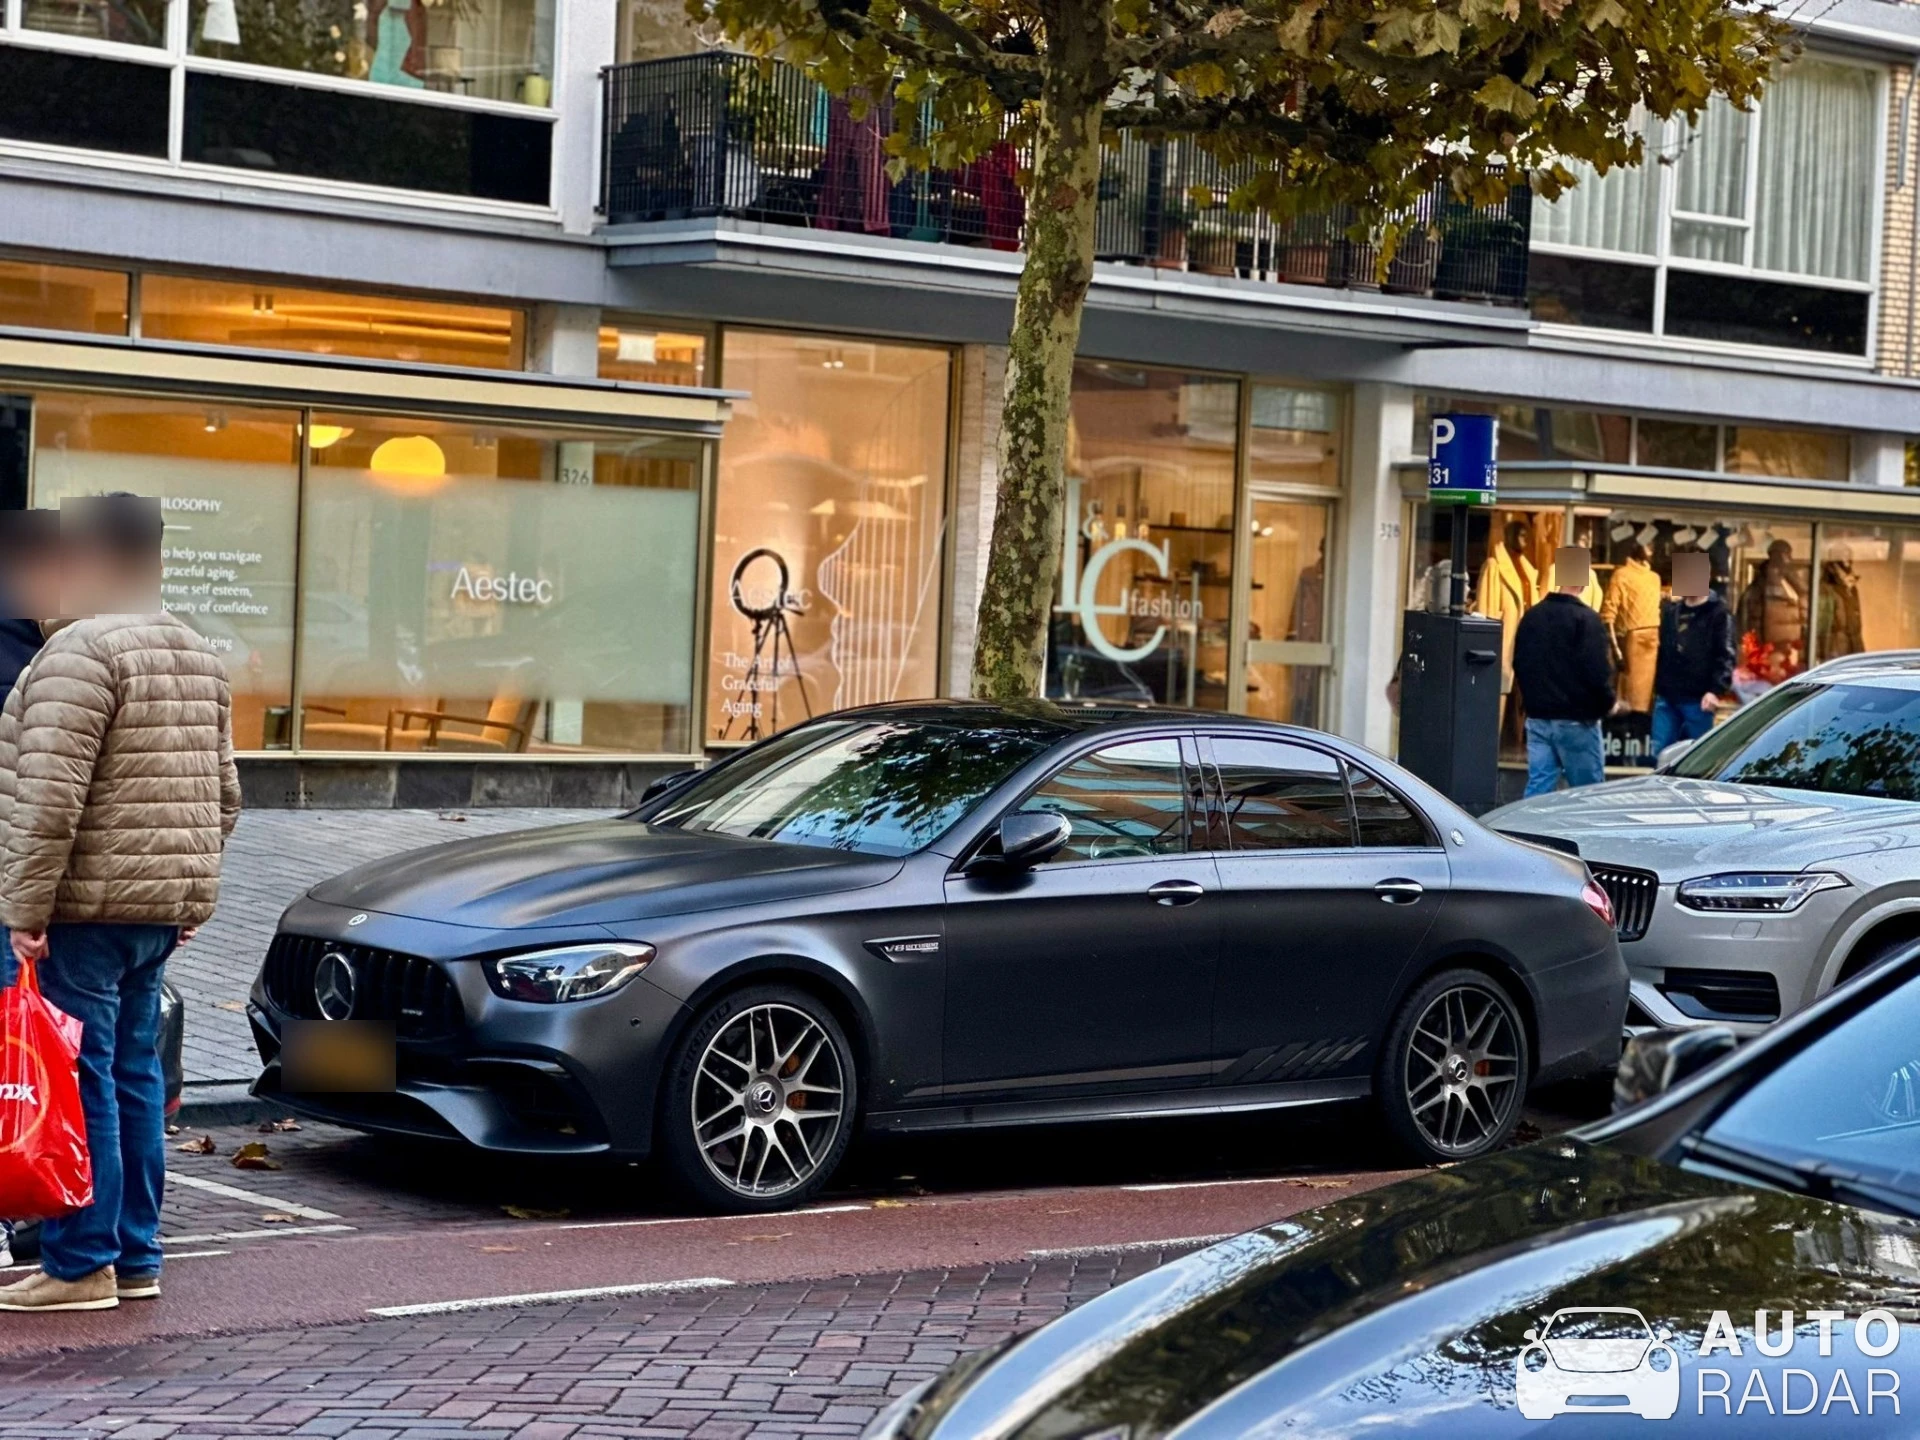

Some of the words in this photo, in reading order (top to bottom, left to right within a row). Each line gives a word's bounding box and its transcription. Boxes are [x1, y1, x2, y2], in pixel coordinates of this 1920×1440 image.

[1432, 418, 1456, 460] P
[561, 468, 589, 485] 326
[161, 497, 222, 512] ILOSOPHY
[172, 548, 196, 561] help
[197, 552, 217, 563] you
[218, 550, 262, 564] navigate
[162, 564, 205, 580] graceful
[167, 582, 189, 595] true
[191, 583, 210, 596] self
[451, 567, 553, 604] Aestec
[162, 600, 198, 616] beauty
[199, 601, 213, 614] of
[212, 602, 270, 616] confidence
[1130, 588, 1204, 621] fashion
[723, 652, 748, 668] The
[720, 698, 762, 718] Aging
[1603, 731, 1622, 757] de
[1624, 731, 1641, 757] in
[884, 944, 904, 952] V8
